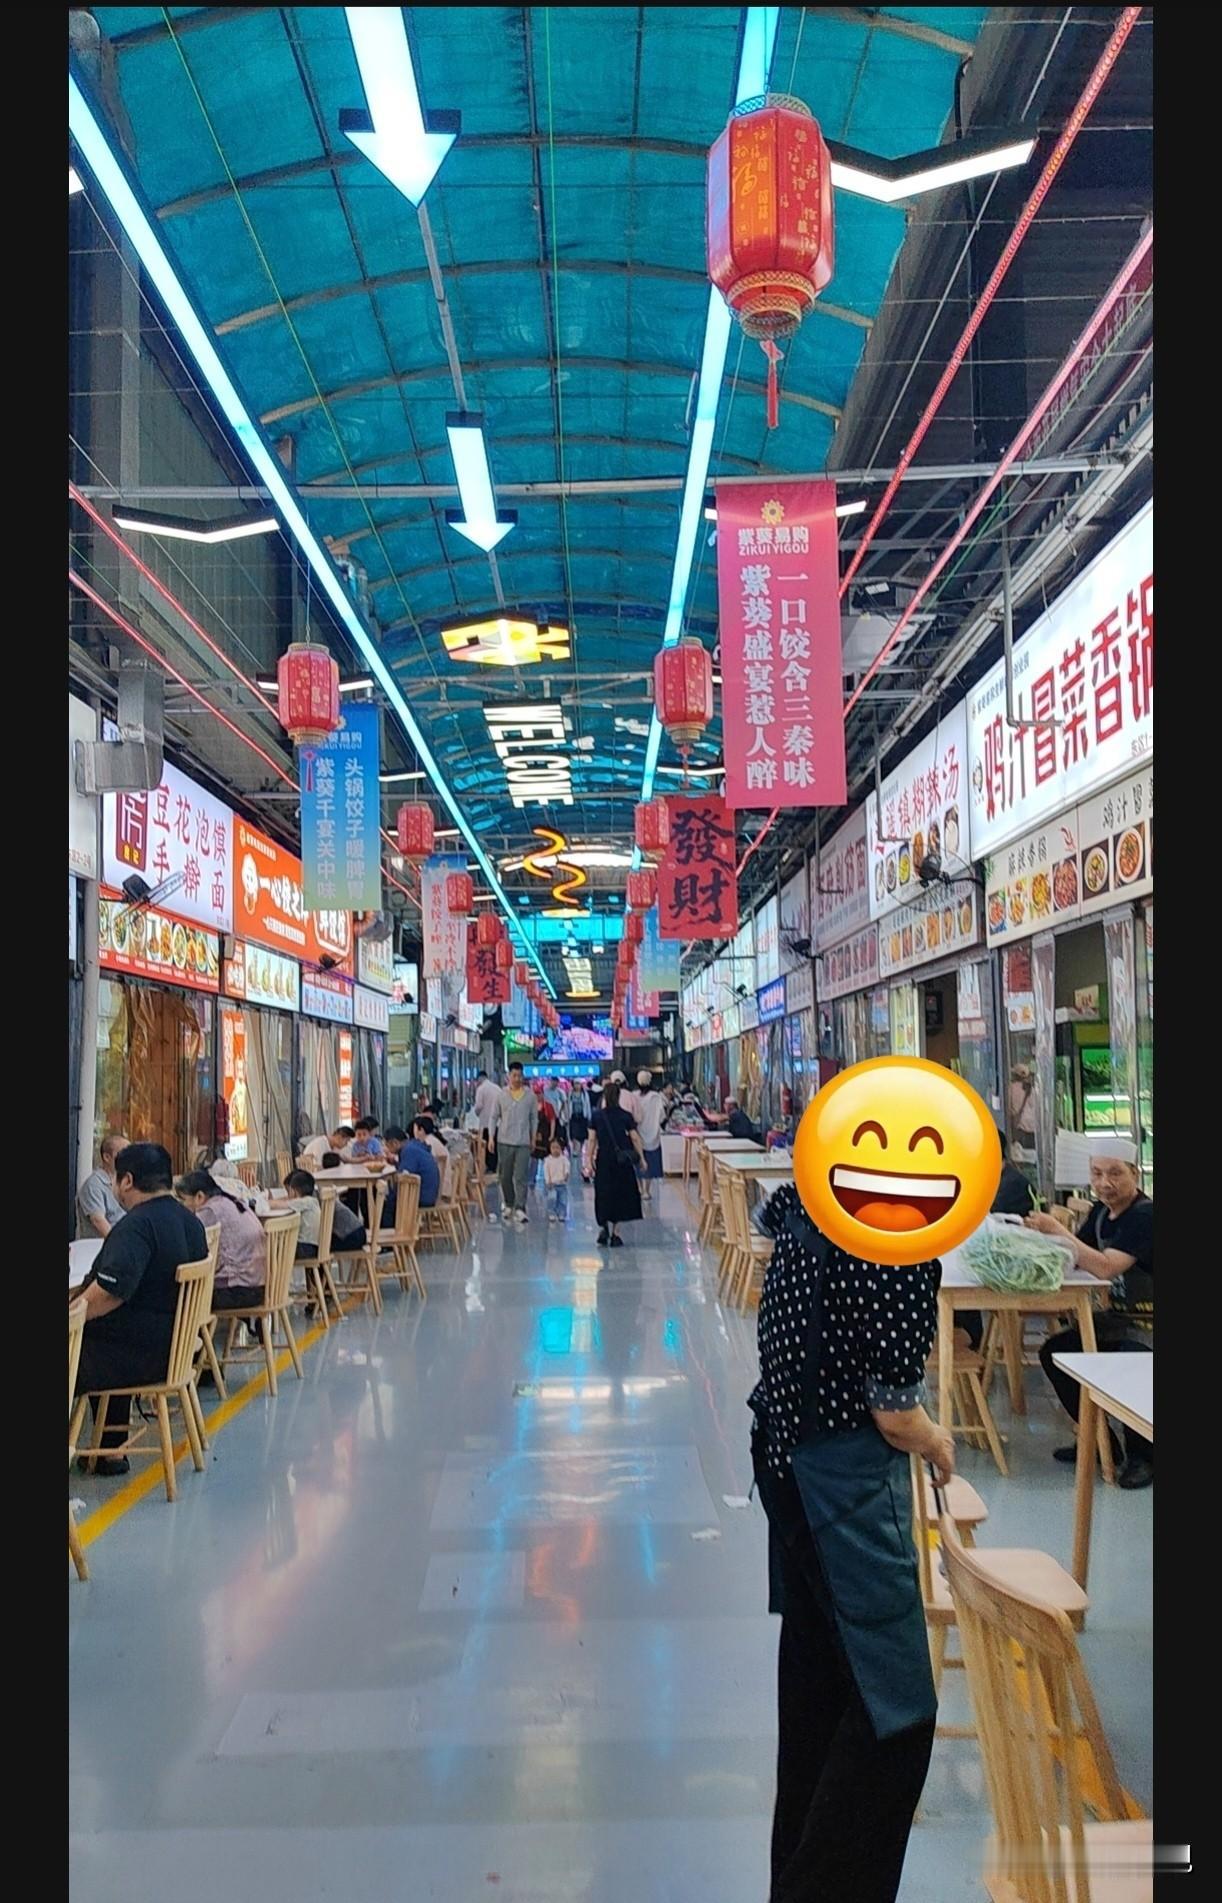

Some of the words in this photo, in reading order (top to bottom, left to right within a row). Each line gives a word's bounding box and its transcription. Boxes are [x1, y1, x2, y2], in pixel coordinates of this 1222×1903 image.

[738, 526, 809, 545] 紫葵易购
[740, 564, 778, 790] 紫葵盛宴惹人醉
[777, 571, 815, 788] 一口饺含三秦味
[984, 573, 1152, 823] 鸡汁冒菜香锅
[483, 703, 574, 809] WELCOME
[1101, 776, 1152, 830] 鸡汁冒
[152, 783, 226, 867] 豆花泡馍
[668, 808, 736, 924] 發財
